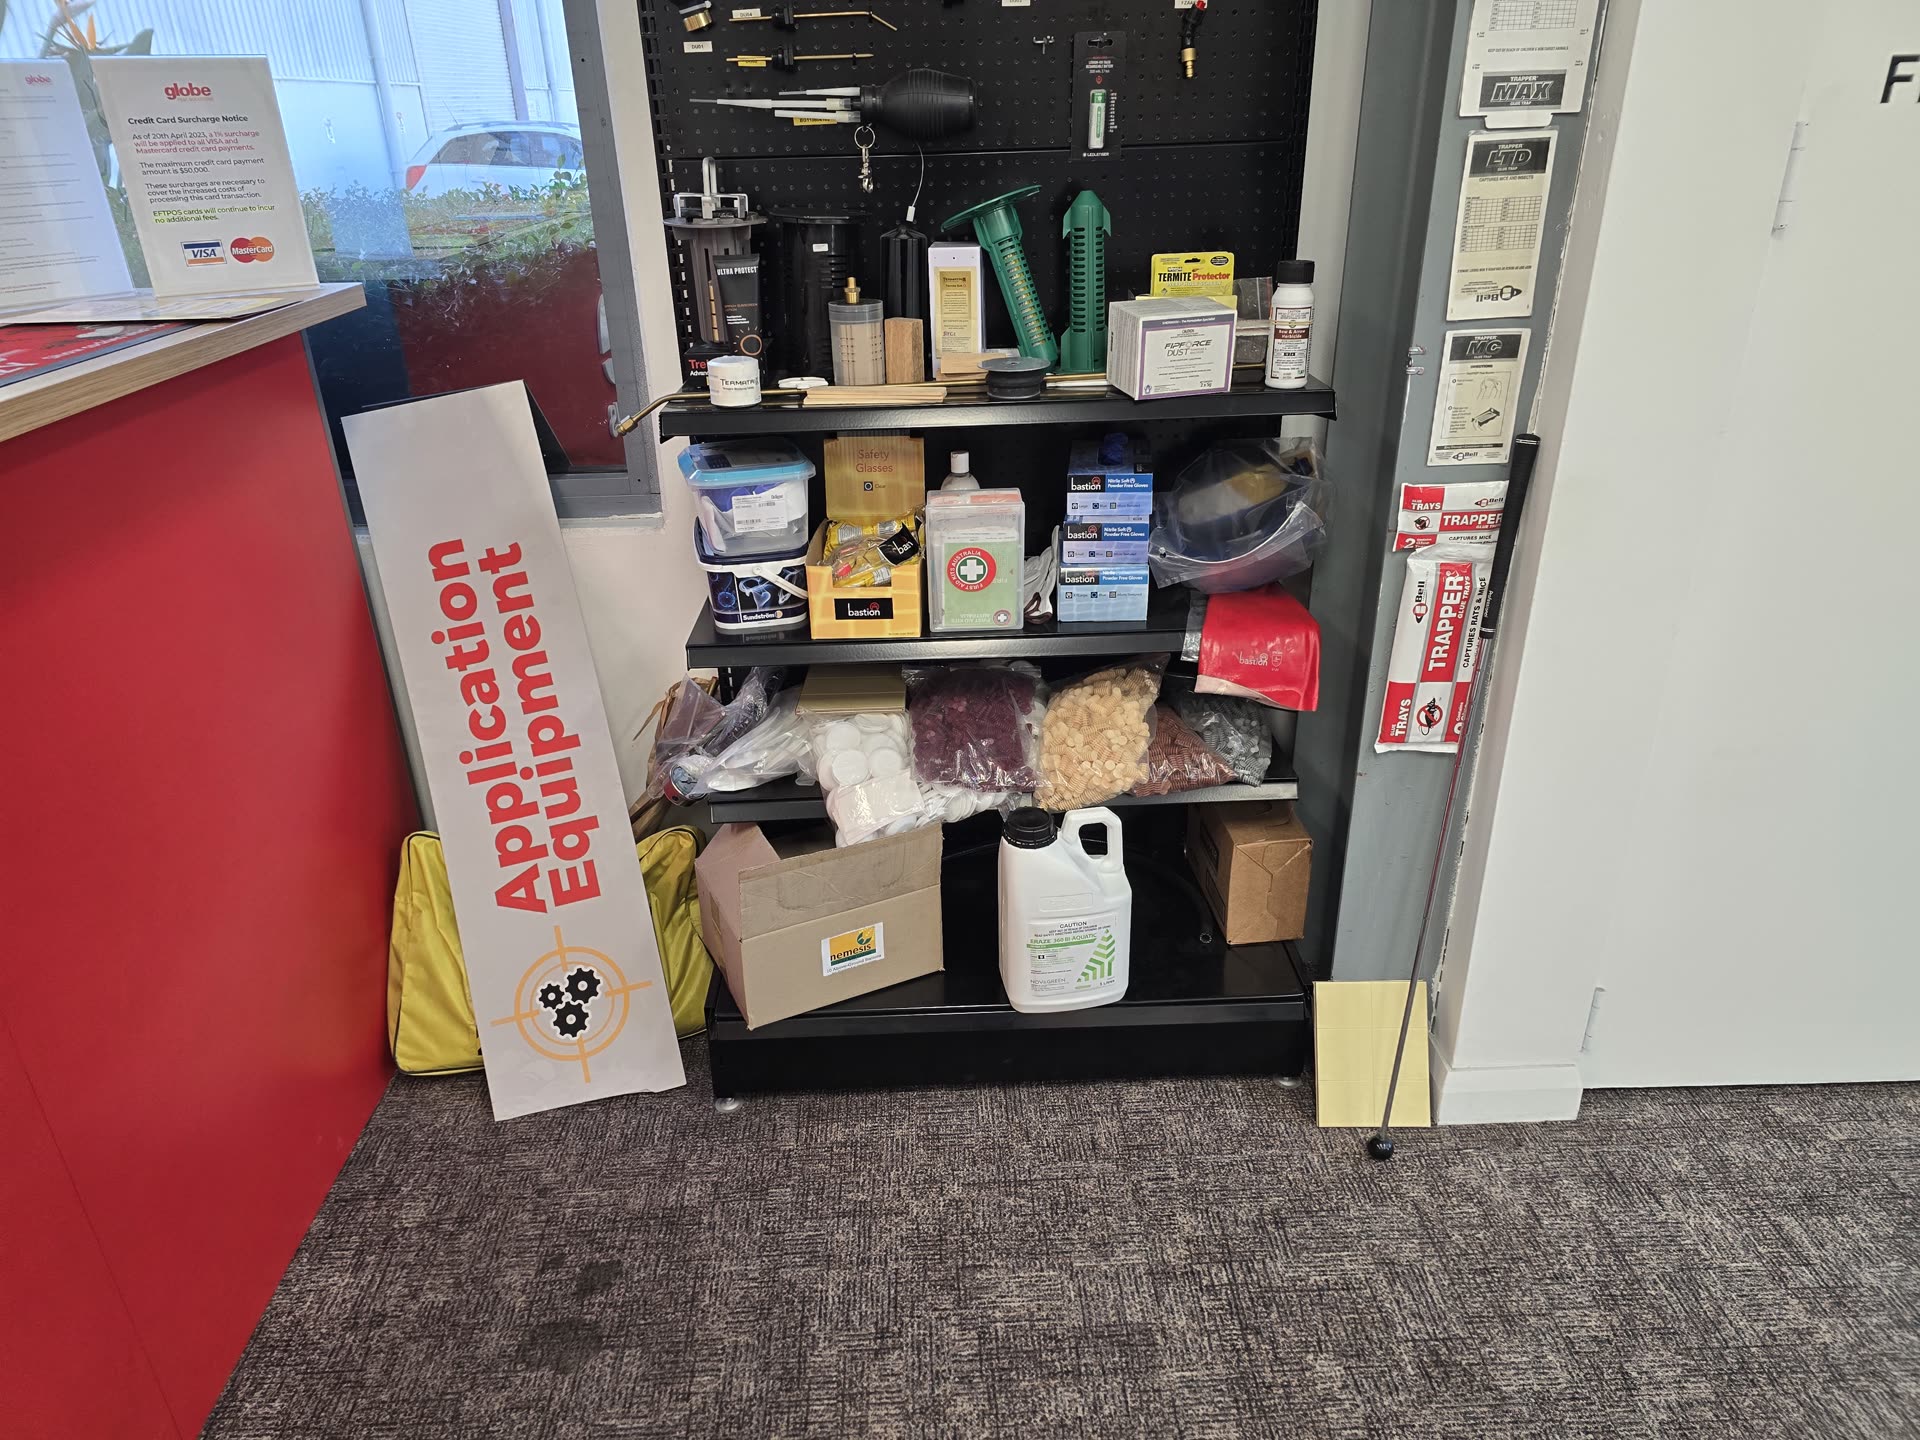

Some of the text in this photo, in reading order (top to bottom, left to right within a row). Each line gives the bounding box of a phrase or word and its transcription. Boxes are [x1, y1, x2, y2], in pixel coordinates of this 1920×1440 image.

[25, 75, 52, 85] globe
[165, 83, 211, 100] globe
[1490, 81, 1554, 102] MAX
[178, 115, 220, 123] Surcharge
[222, 114, 248, 122] Notice
[170, 132, 187, 140] April
[224, 130, 260, 138] surcharge
[159, 139, 186, 148] applied
[218, 144, 255, 152] payments.
[233, 158, 264, 166] payment
[1486, 149, 1532, 167] LTD
[169, 181, 208, 190] surcharges
[149, 195, 189, 204] processing
[166, 215, 202, 223] additional
[192, 248, 217, 258] VISA
[232, 245, 273, 255] MasterCard
[717, 265, 757, 275] ULTRA PROTECT
[1158, 272, 1230, 282] TERMITE Protector
[1476, 293, 1499, 303] Bell
[1164, 339, 1212, 349] FIPFORCE
[1466, 340, 1502, 356] MC
[1167, 349, 1188, 357] DUST
[689, 360, 707, 369] Tre
[857, 449, 889, 462] Safety
[855, 463, 893, 473] Glasses
[1071, 477, 1101, 491] bastion
[1067, 525, 1098, 539] bastion
[1404, 538, 1416, 549] 2
[952, 550, 982, 567] AUSTRALIA
[1065, 570, 1095, 583] bastion
[955, 580, 964, 588] AID
[1415, 581, 1425, 603] Bell
[847, 603, 881, 617] bastion
[1457, 600, 1466, 619] GLUE
[1463, 628, 1476, 668] CAPTURES
[1471, 605, 1481, 626] RATS
[1477, 577, 1486, 598] MICE
[1239, 651, 1268, 666] bastion
[1456, 702, 1464, 721] Contains
[1395, 699, 1412, 736] TRAYS
[428, 538, 548, 913] Application
[478, 542, 601, 907] Equipment
[1060, 921, 1087, 929] CAUTION
[830, 943, 872, 961] nemesis
